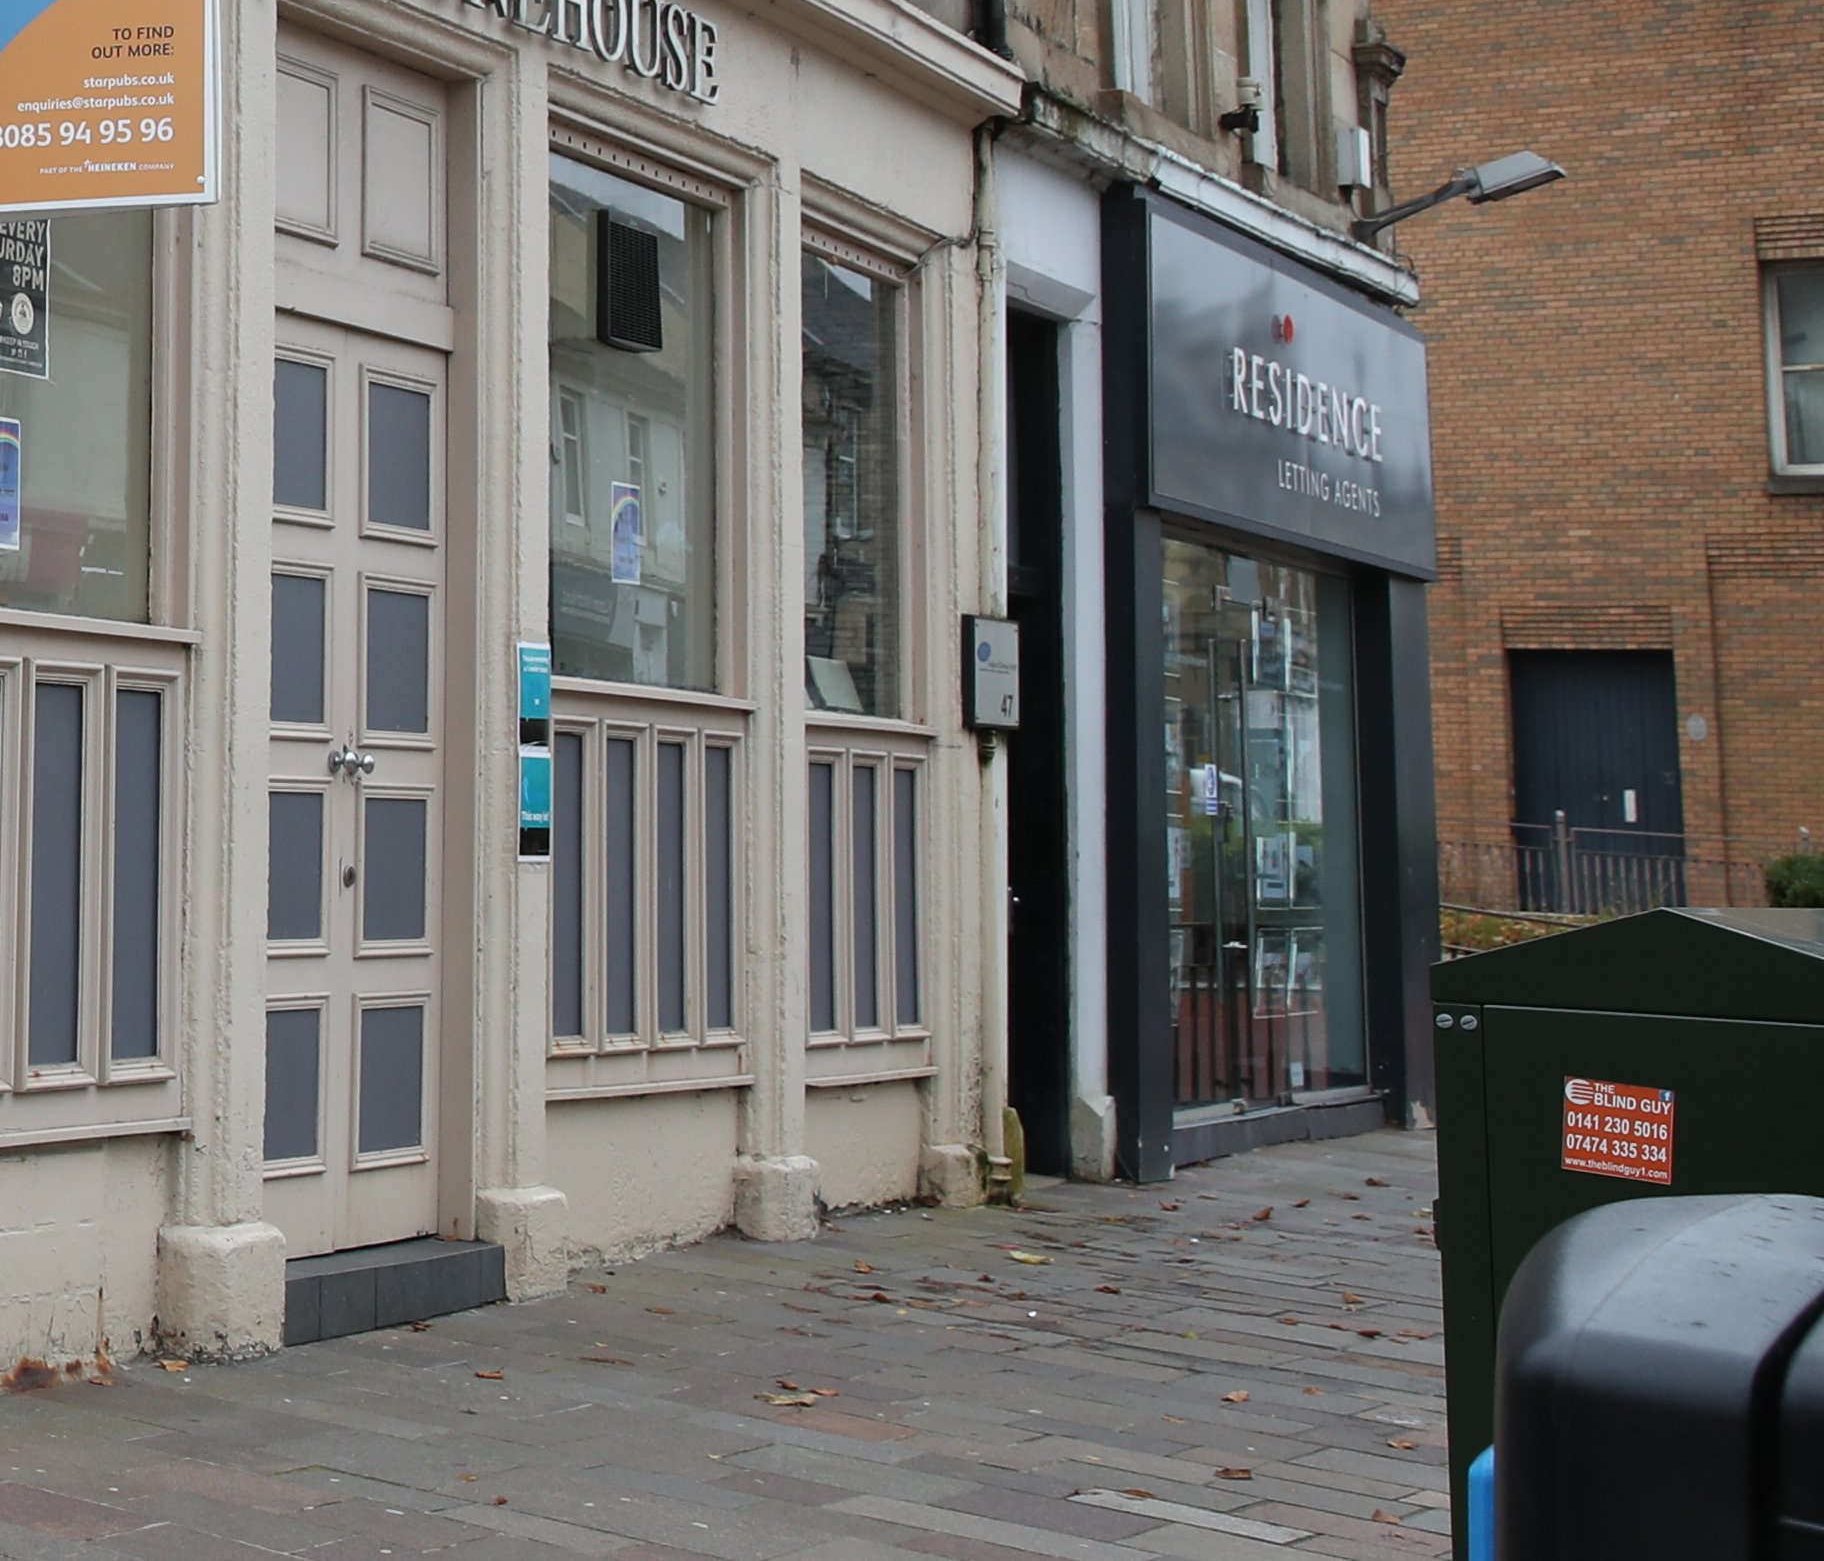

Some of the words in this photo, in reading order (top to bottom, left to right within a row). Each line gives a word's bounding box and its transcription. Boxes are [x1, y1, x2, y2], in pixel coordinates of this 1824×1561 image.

[112, 28, 132, 41] TO
[137, 25, 174, 39] FIND
[91, 46, 123, 59] OUT
[128, 43, 174, 57] MORE:
[83, 72, 174, 89] starpubs.co.uk
[17, 93, 174, 113] enquiries@starpubs.co.uk
[59, 120, 92, 146] 94
[99, 118, 132, 144] 95
[139, 117, 174, 142] 96
[39, 167, 57, 175] PART
[88, 162, 137, 172] HEINEKEN
[138, 163, 174, 171] COMPANY
[12, 264, 44, 291] 8PM
[1233, 347, 1382, 463] RESIDENCE
[1278, 459, 1329, 501] LETTING
[1334, 479, 1380, 518] AGENTS
[1001, 694, 1014, 718] 47
[1594, 1083, 1615, 1093] THE
[1594, 1093, 1637, 1110] BLIND
[1641, 1099, 1671, 1115] GUY
[1568, 1111, 1599, 1130] 0141
[1604, 1117, 1630, 1134] 230
[1634, 1121, 1667, 1140] 5016
[1567, 1133, 1607, 1154] 07474
[1612, 1140, 1637, 1158] 335
[1641, 1144, 1667, 1163] 334
[1565, 1157, 1668, 1179] www.theblindguy1.com
